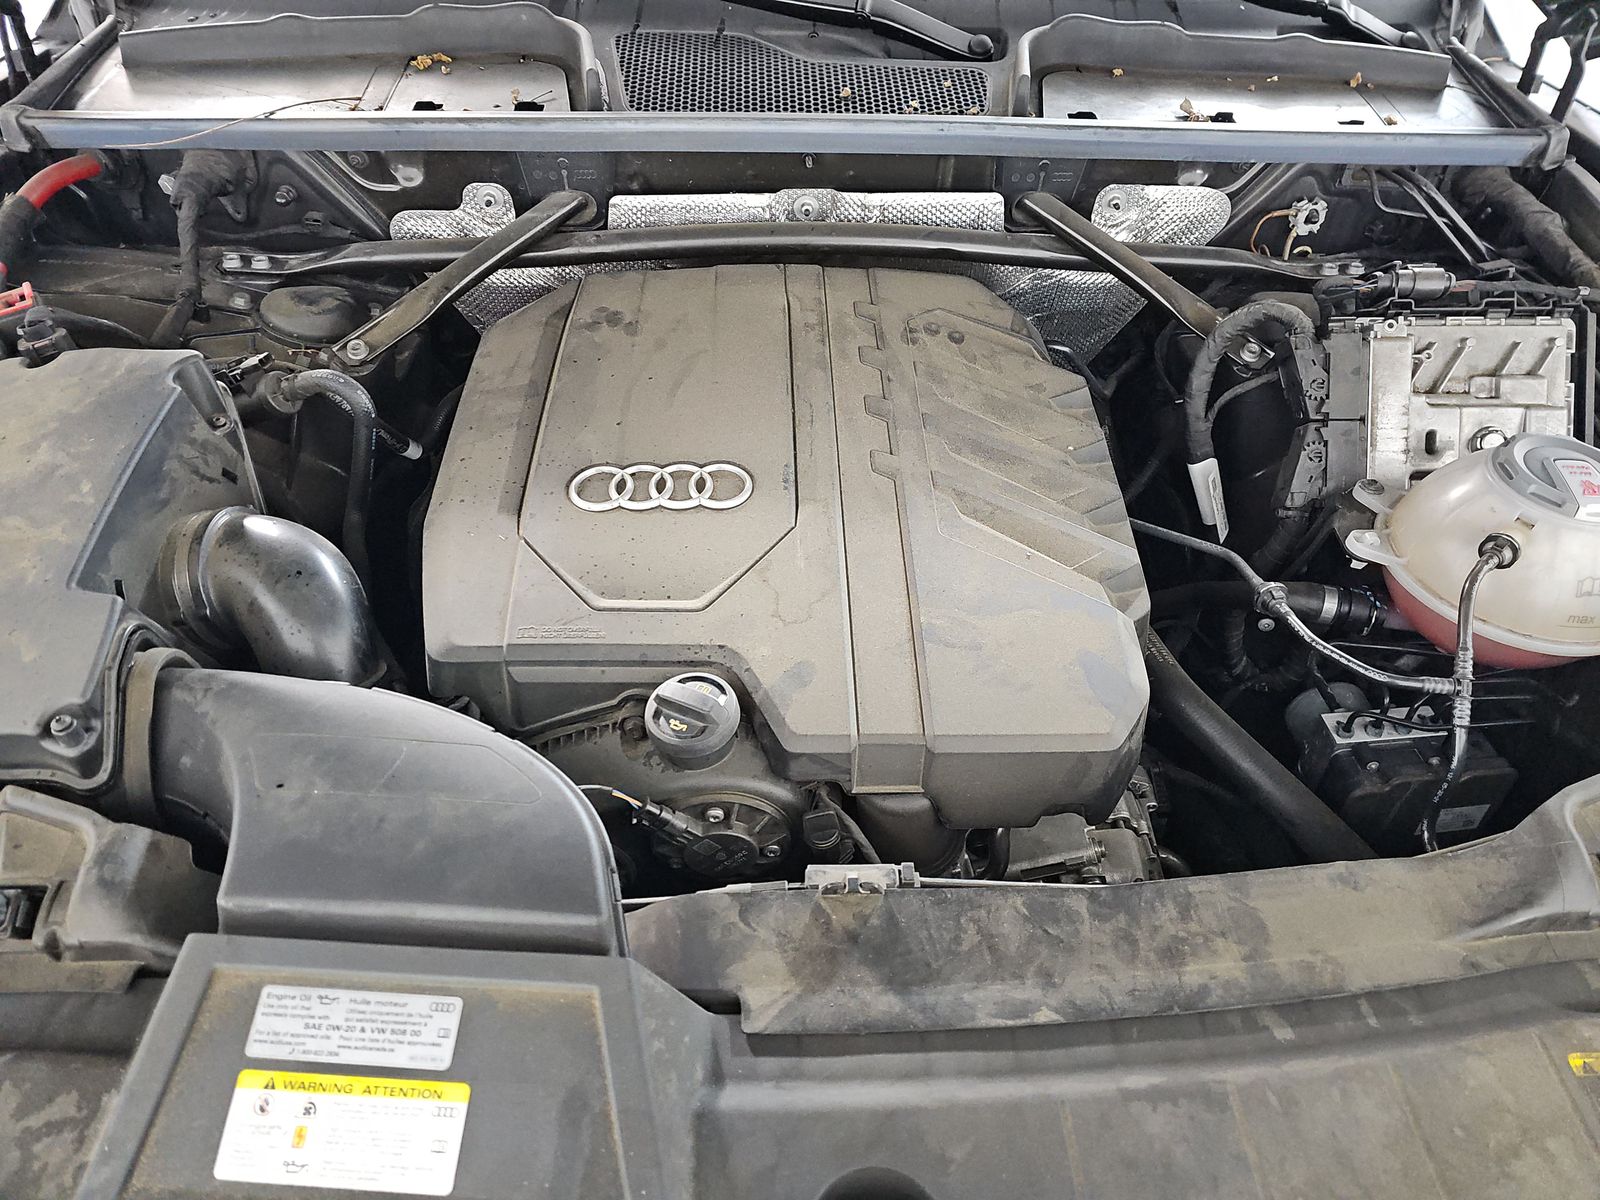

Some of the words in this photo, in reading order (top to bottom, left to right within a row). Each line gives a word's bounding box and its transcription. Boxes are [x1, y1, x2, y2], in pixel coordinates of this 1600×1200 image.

[1568, 615, 1597, 625] max
[267, 992, 297, 1001] Engine
[349, 998, 372, 1006] Huile
[303, 1022, 324, 1031] SAE
[326, 1024, 357, 1033] 0W-20
[359, 1025, 367, 1033] &
[369, 1027, 389, 1035] VW
[409, 1029, 422, 1037] 00
[282, 1080, 354, 1094] WARNING
[362, 1085, 444, 1099] ATTENTION
